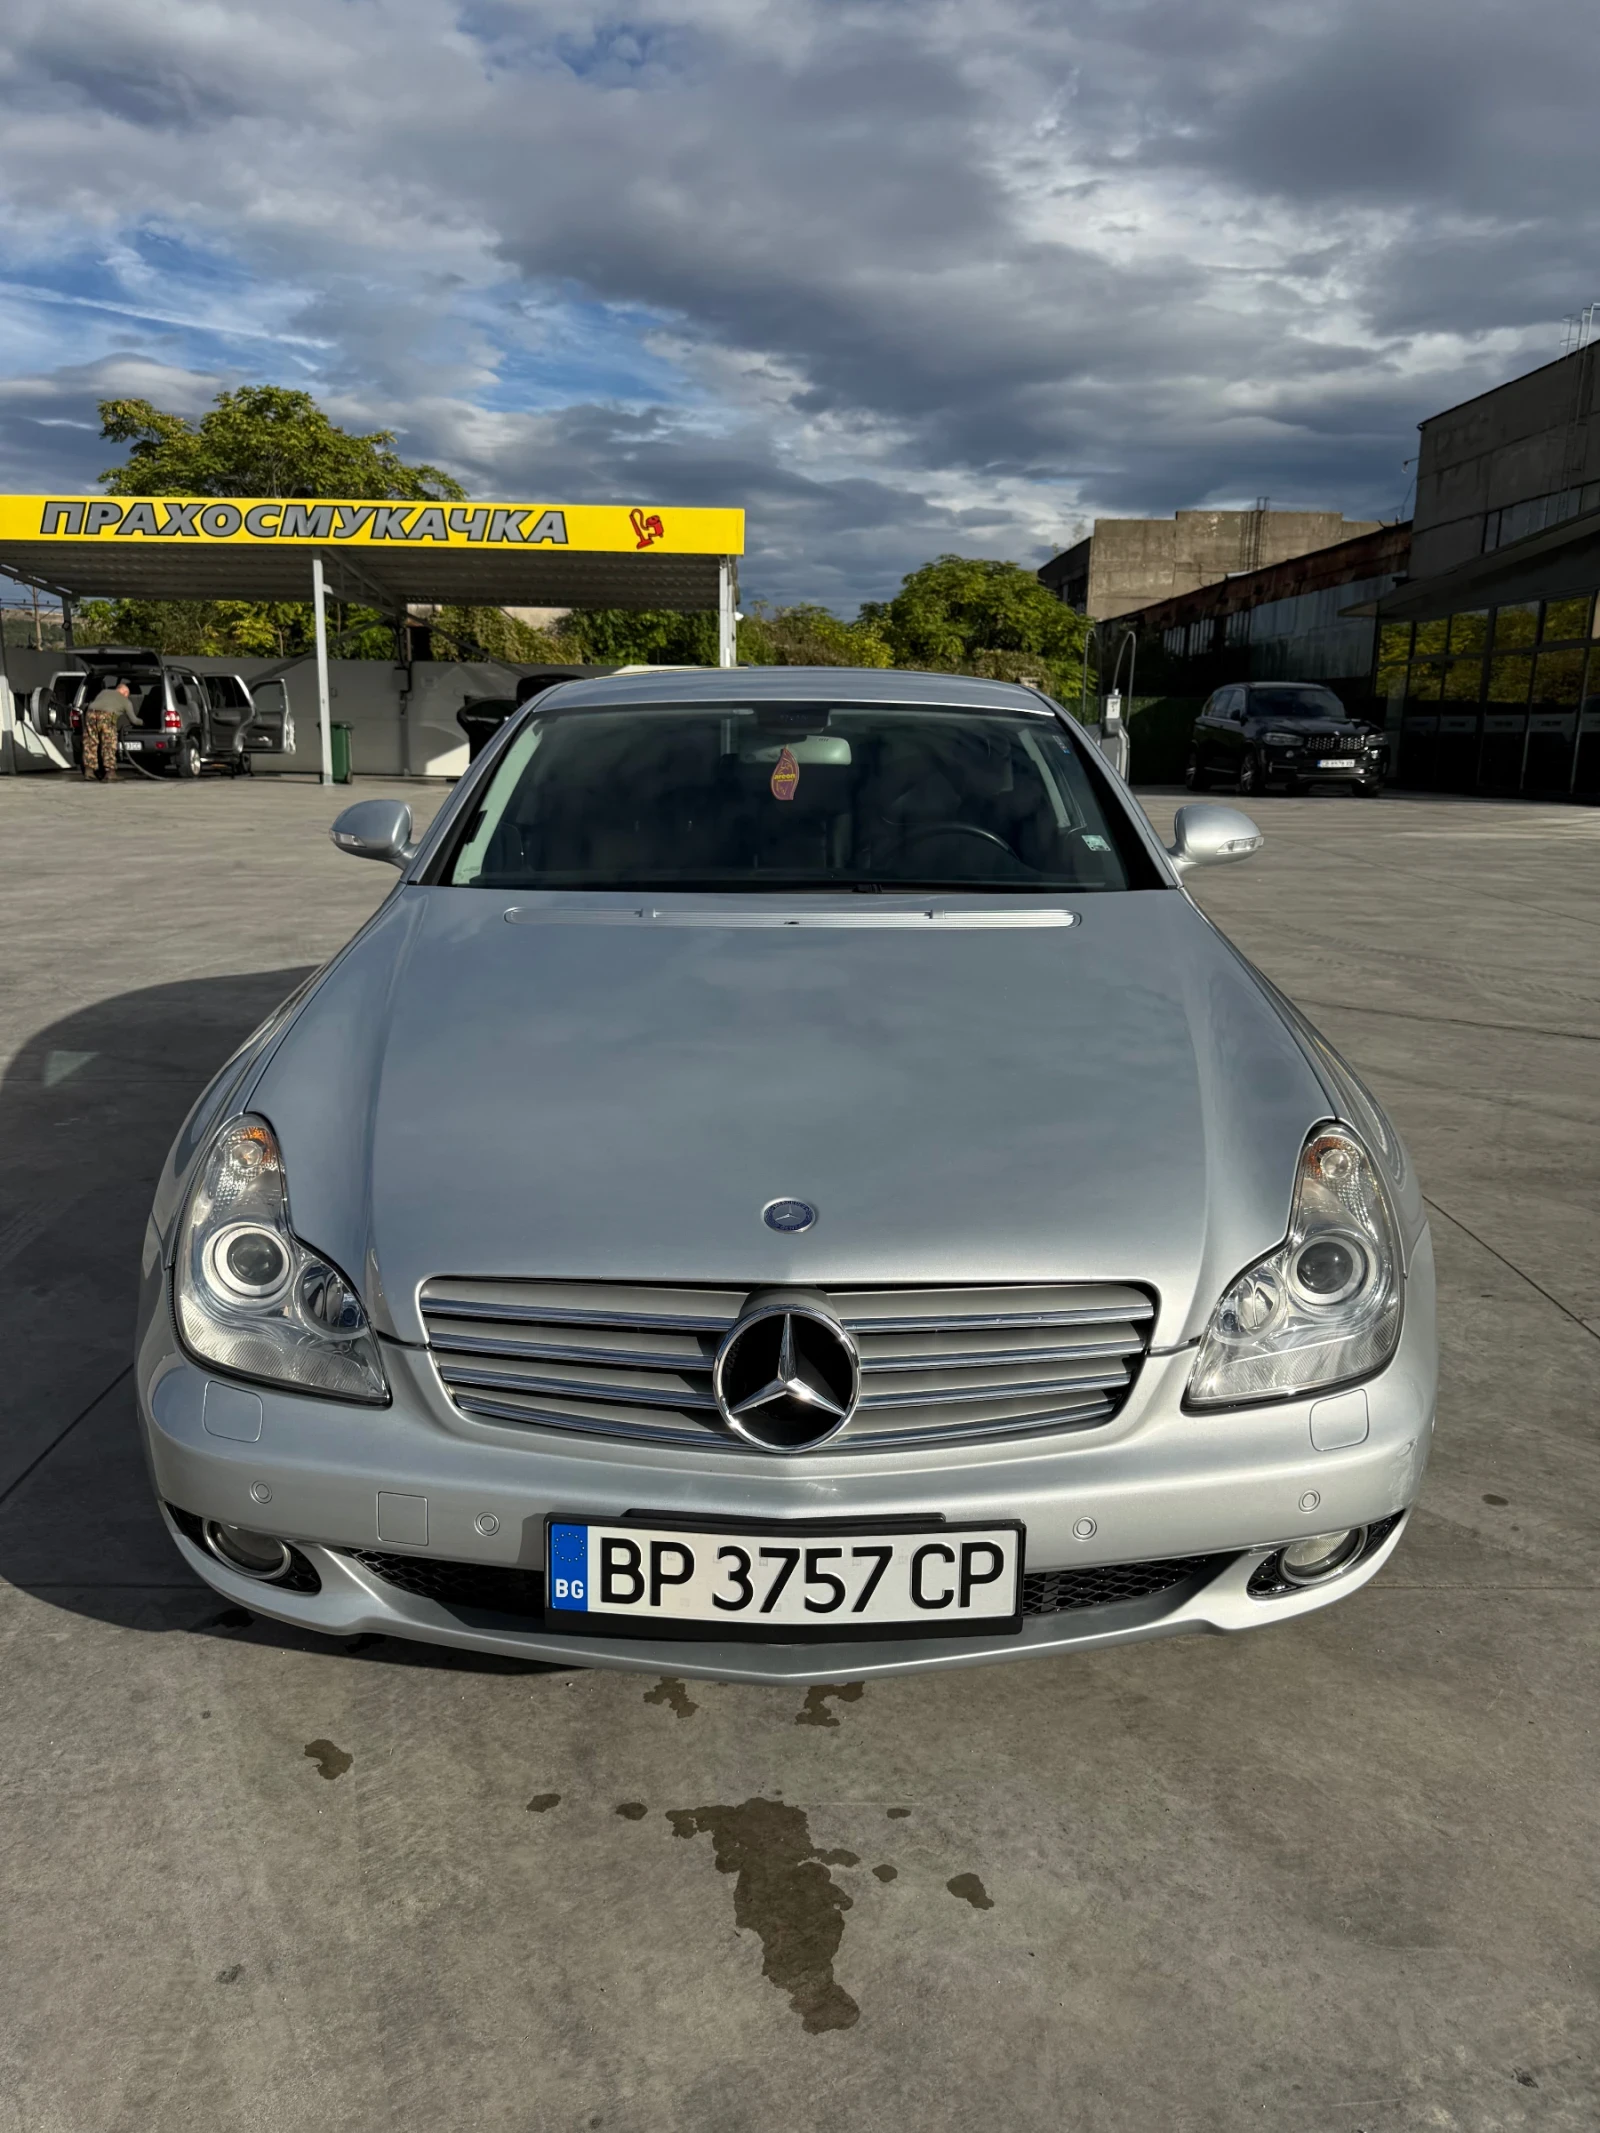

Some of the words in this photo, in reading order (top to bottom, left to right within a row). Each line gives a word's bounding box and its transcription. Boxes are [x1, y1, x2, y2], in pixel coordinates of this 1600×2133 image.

[40, 501, 568, 544] ПРАХОСМУКАЧКА
[555, 1578, 584, 1599] BG
[600, 1537, 695, 1606] BP
[712, 1545, 893, 1613] 3757
[911, 1541, 1004, 1609] CP
